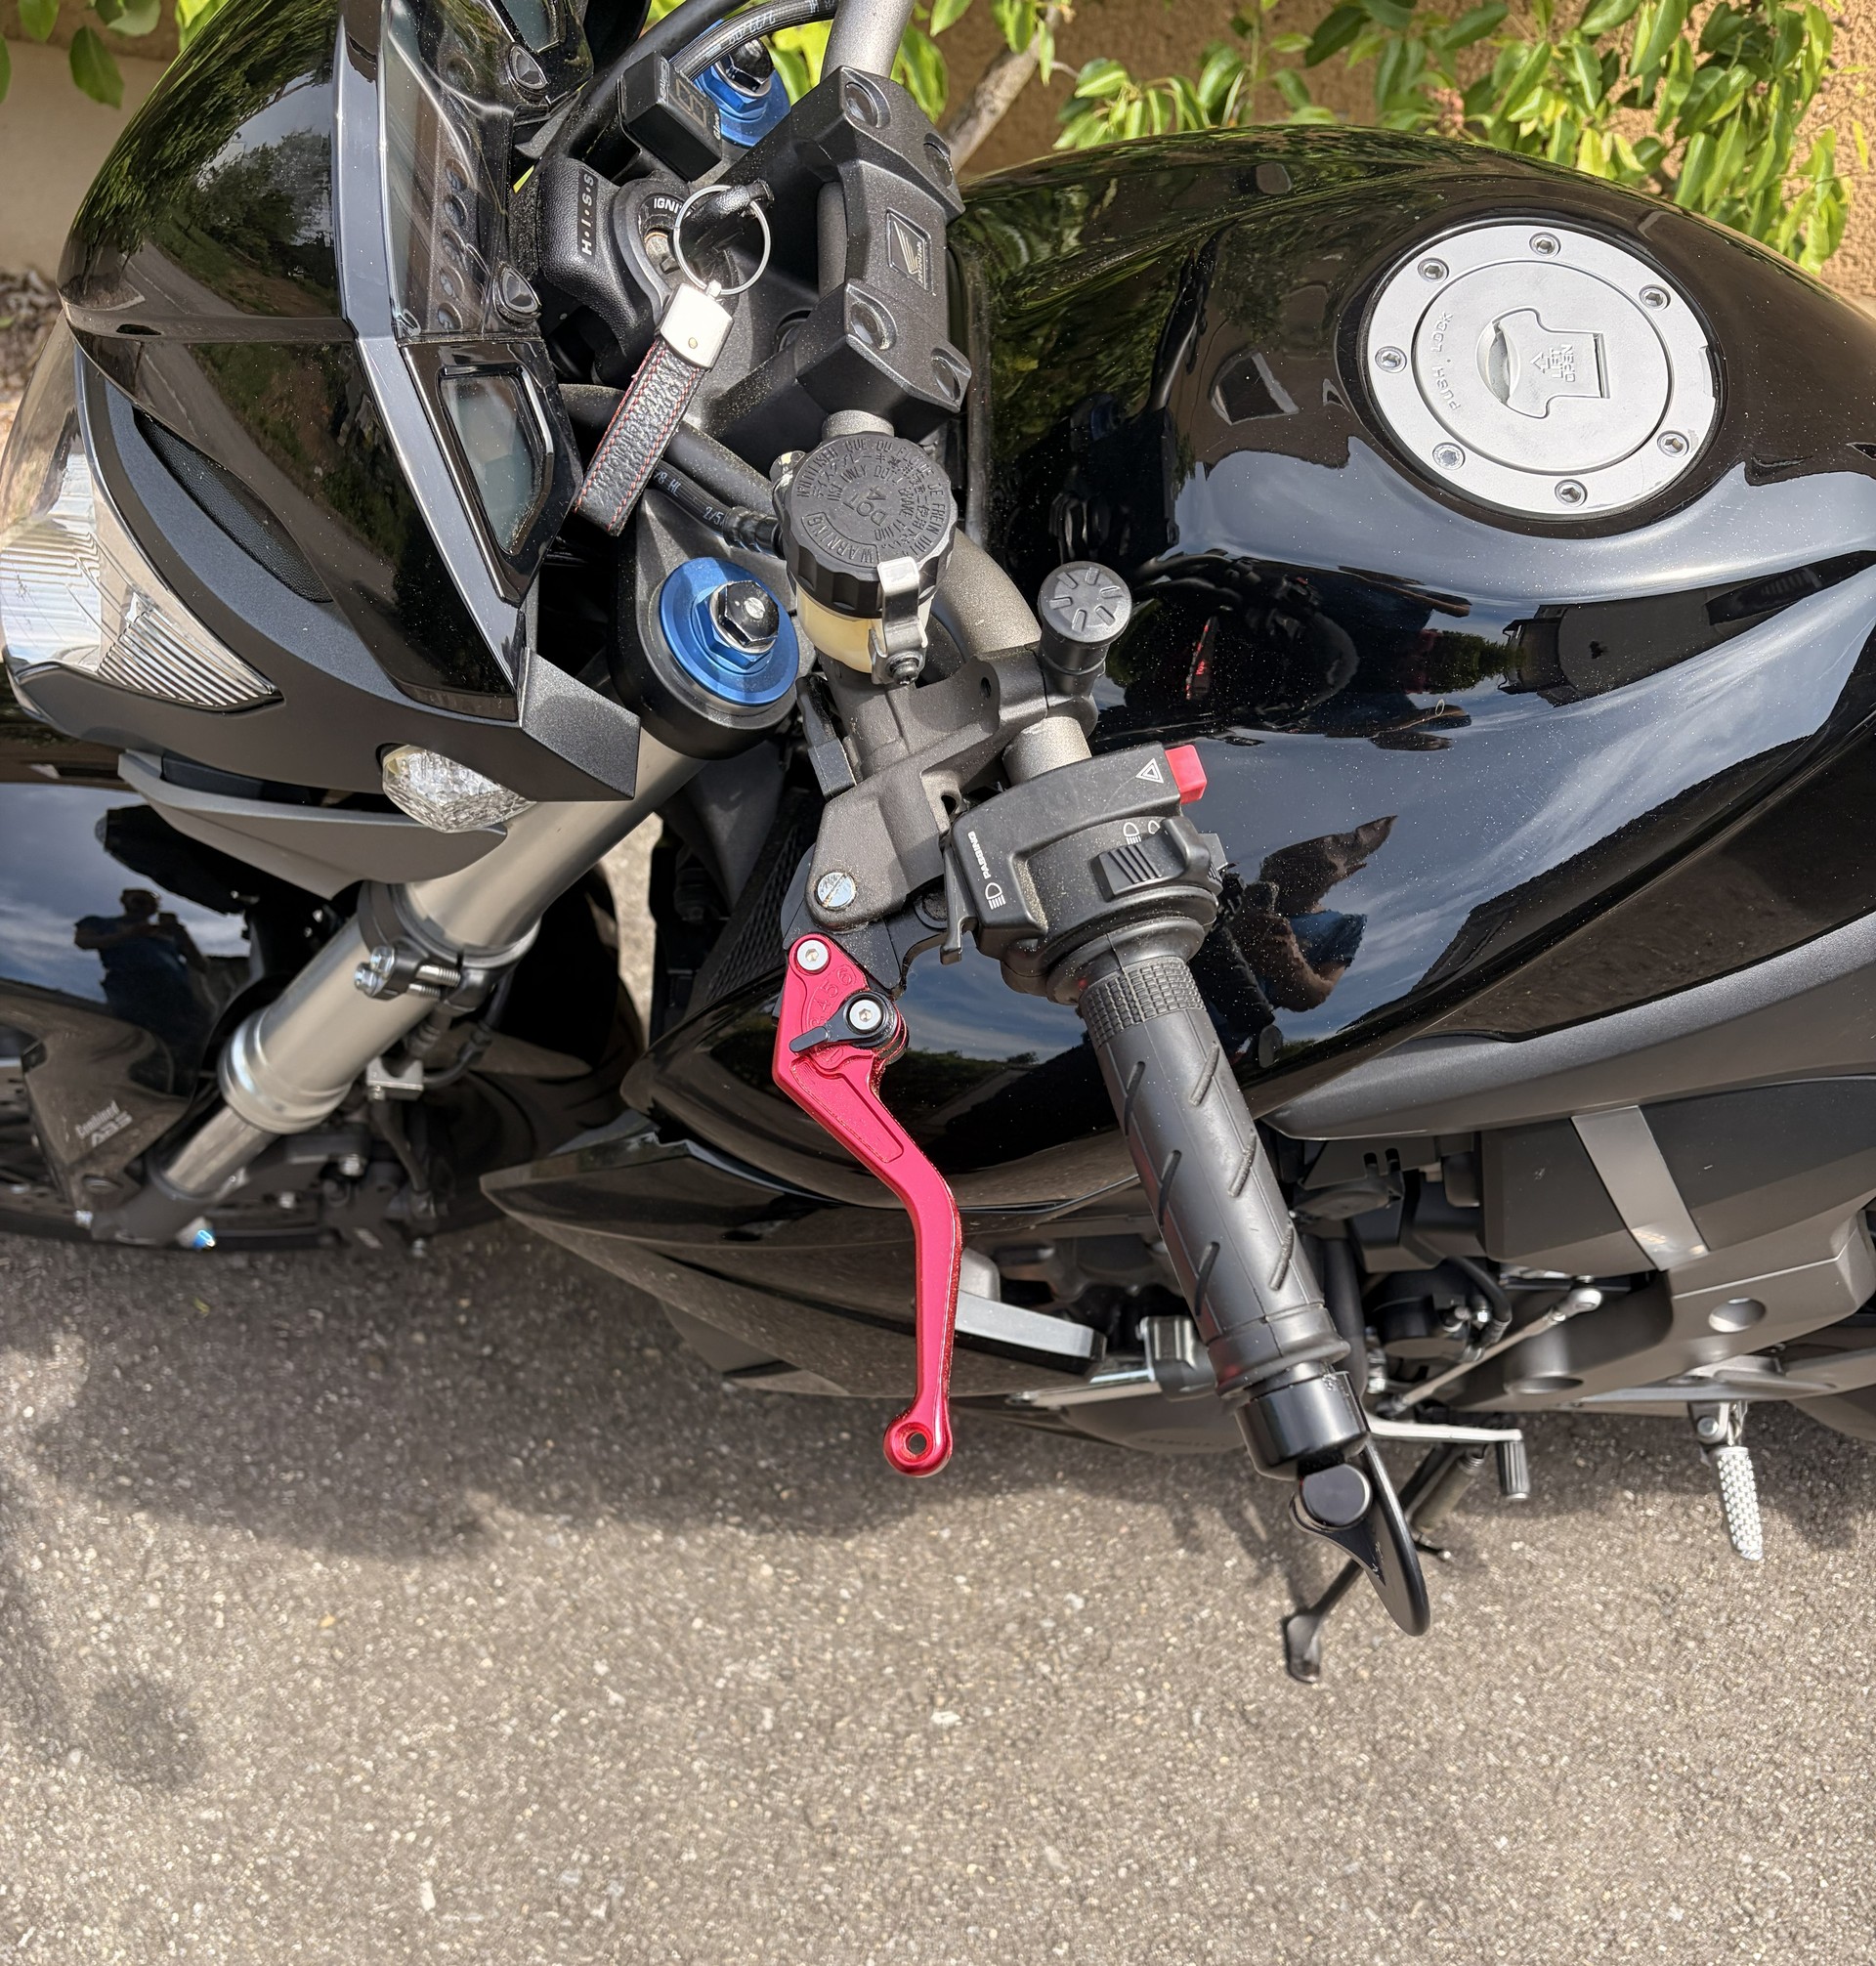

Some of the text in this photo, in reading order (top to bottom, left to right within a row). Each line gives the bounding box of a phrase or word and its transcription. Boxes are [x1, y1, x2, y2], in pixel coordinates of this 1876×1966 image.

[654, 197, 685, 214] IGNI
[1430, 312, 1462, 410] PUSH LOCK
[1549, 348, 1563, 379] LIFT
[1560, 344, 1575, 382] OPEN
[827, 484, 843, 501] USE
[840, 465, 867, 483] ONLY
[845, 439, 868, 453] QUE
[929, 502, 946, 535] FREIN
[866, 486, 887, 501] 4
[842, 493, 887, 526] DOT
[807, 517, 874, 564] WARNING
[968, 832, 992, 879] PASSING
[821, 980, 838, 998] 5
[836, 968, 852, 986] 6
[75, 1099, 120, 1139] Combined
[92, 1110, 132, 1148] ABS
